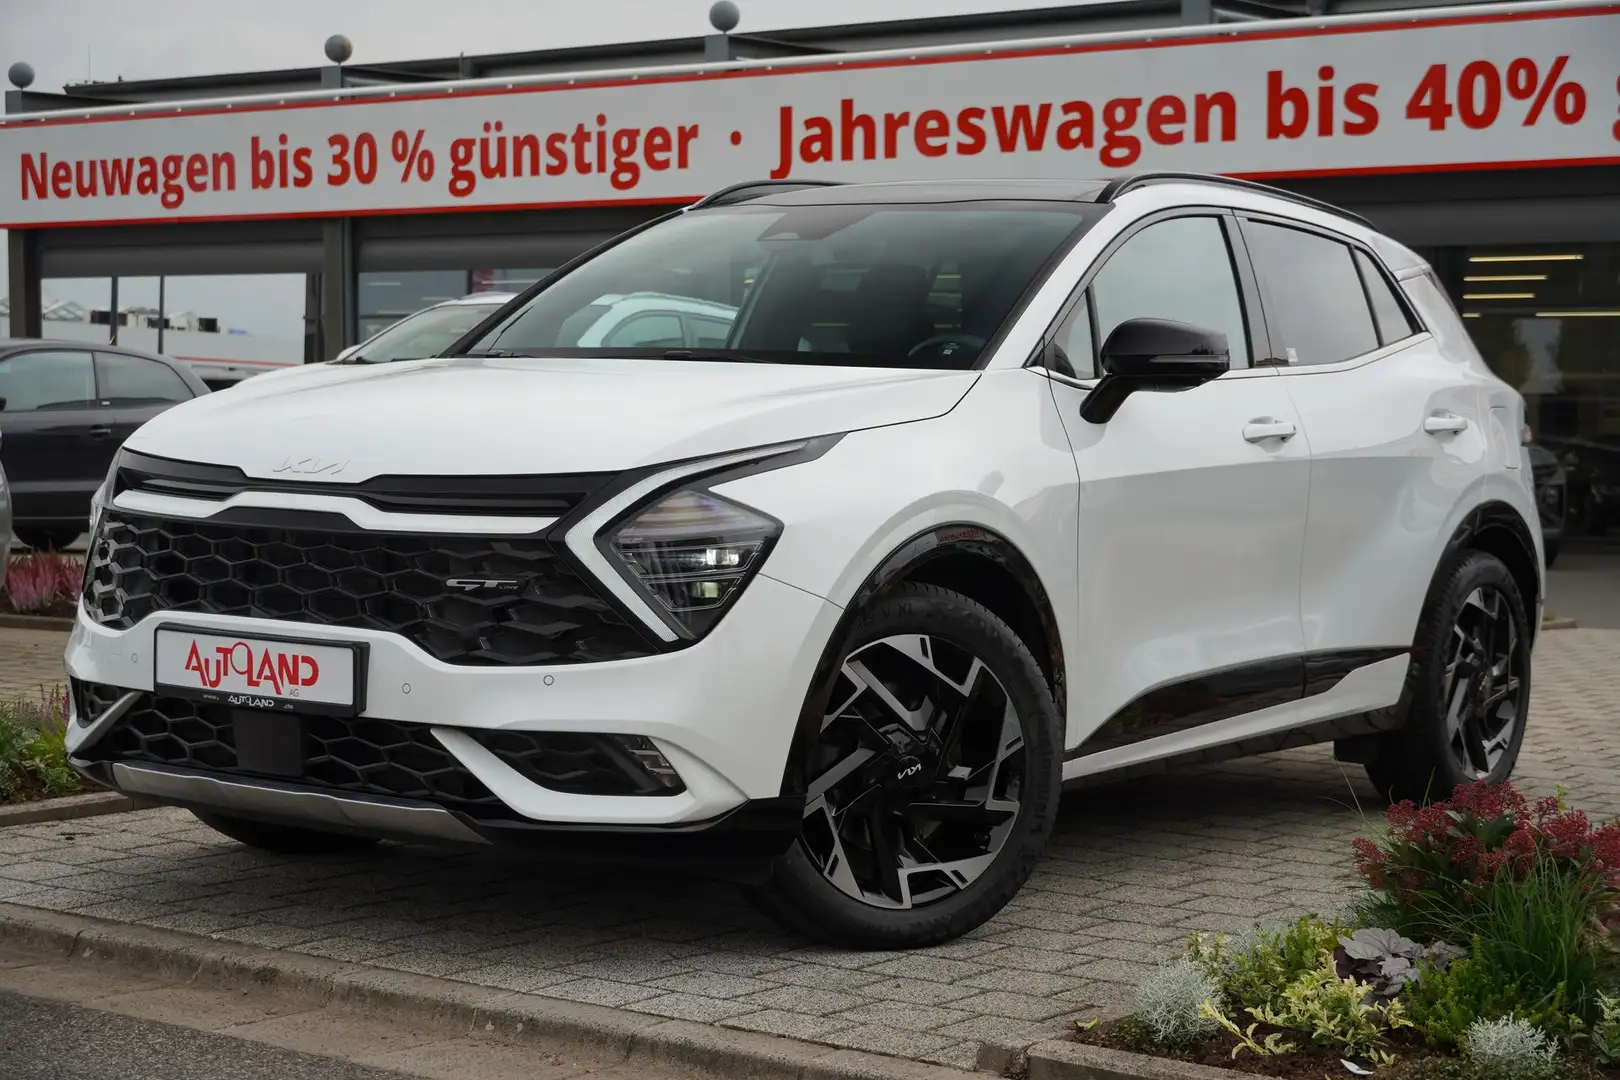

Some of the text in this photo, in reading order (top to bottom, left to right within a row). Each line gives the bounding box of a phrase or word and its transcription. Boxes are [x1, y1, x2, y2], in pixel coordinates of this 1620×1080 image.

[20, 152, 236, 209] Neuwagen
[251, 134, 313, 190] bis
[327, 132, 378, 187] 30
[391, 129, 436, 183] %
[448, 114, 699, 196] günstiger
[769, 91, 1237, 180] Jahreswagen
[1266, 65, 1380, 140] bis
[1406, 55, 1588, 131] 40%
[446, 578, 517, 591] GT
